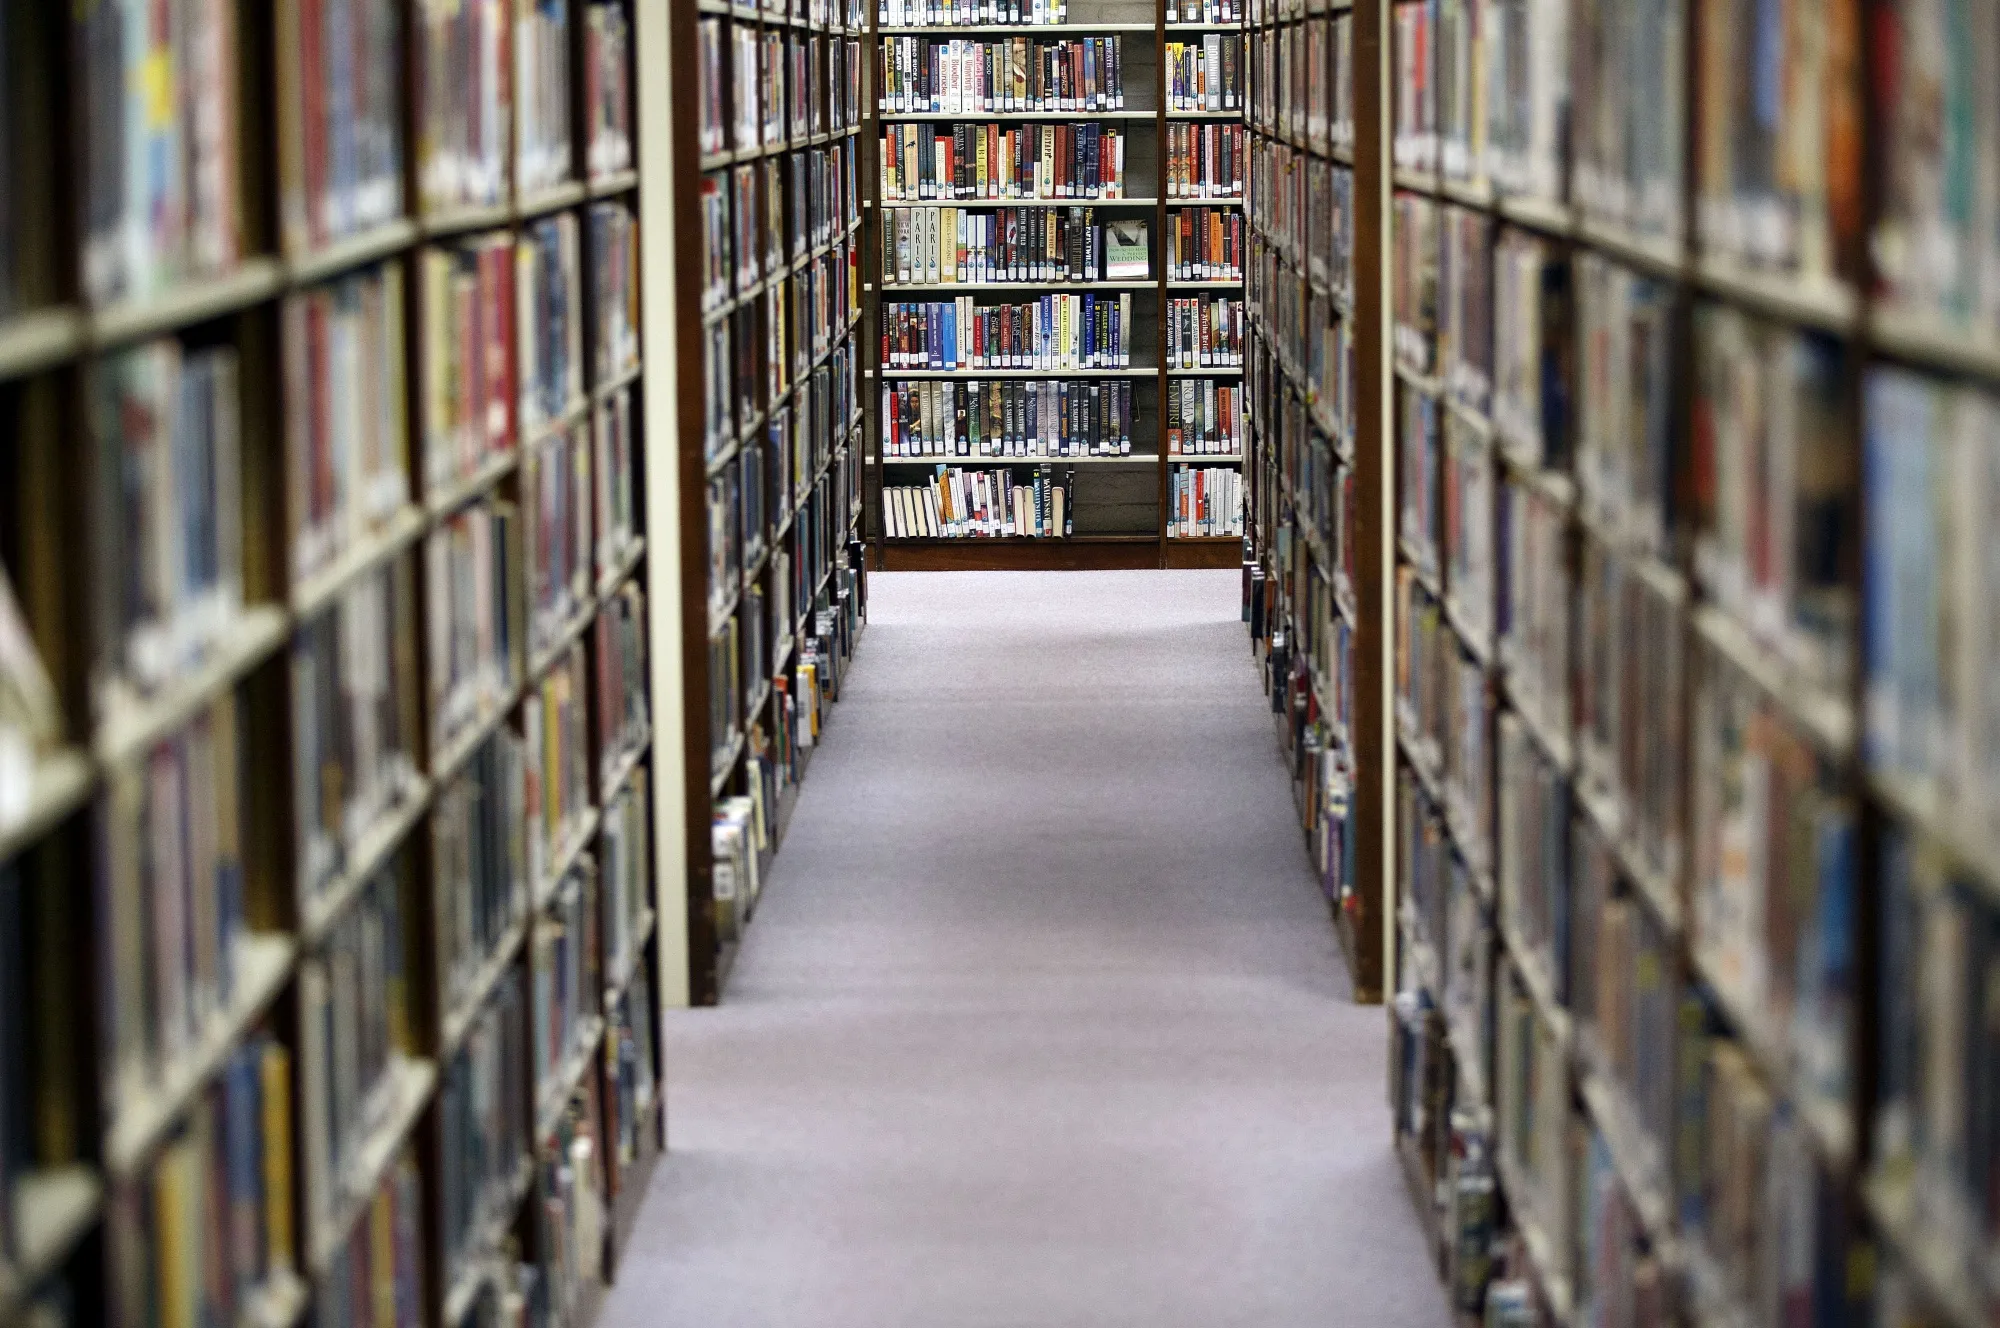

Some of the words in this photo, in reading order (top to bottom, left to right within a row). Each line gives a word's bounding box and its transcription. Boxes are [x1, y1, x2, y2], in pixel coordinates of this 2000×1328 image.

[1208, 46, 1218, 86] DOMINION
[1169, 386, 1179, 428] EMPIRE
[1184, 386, 1194, 418] ROMA
